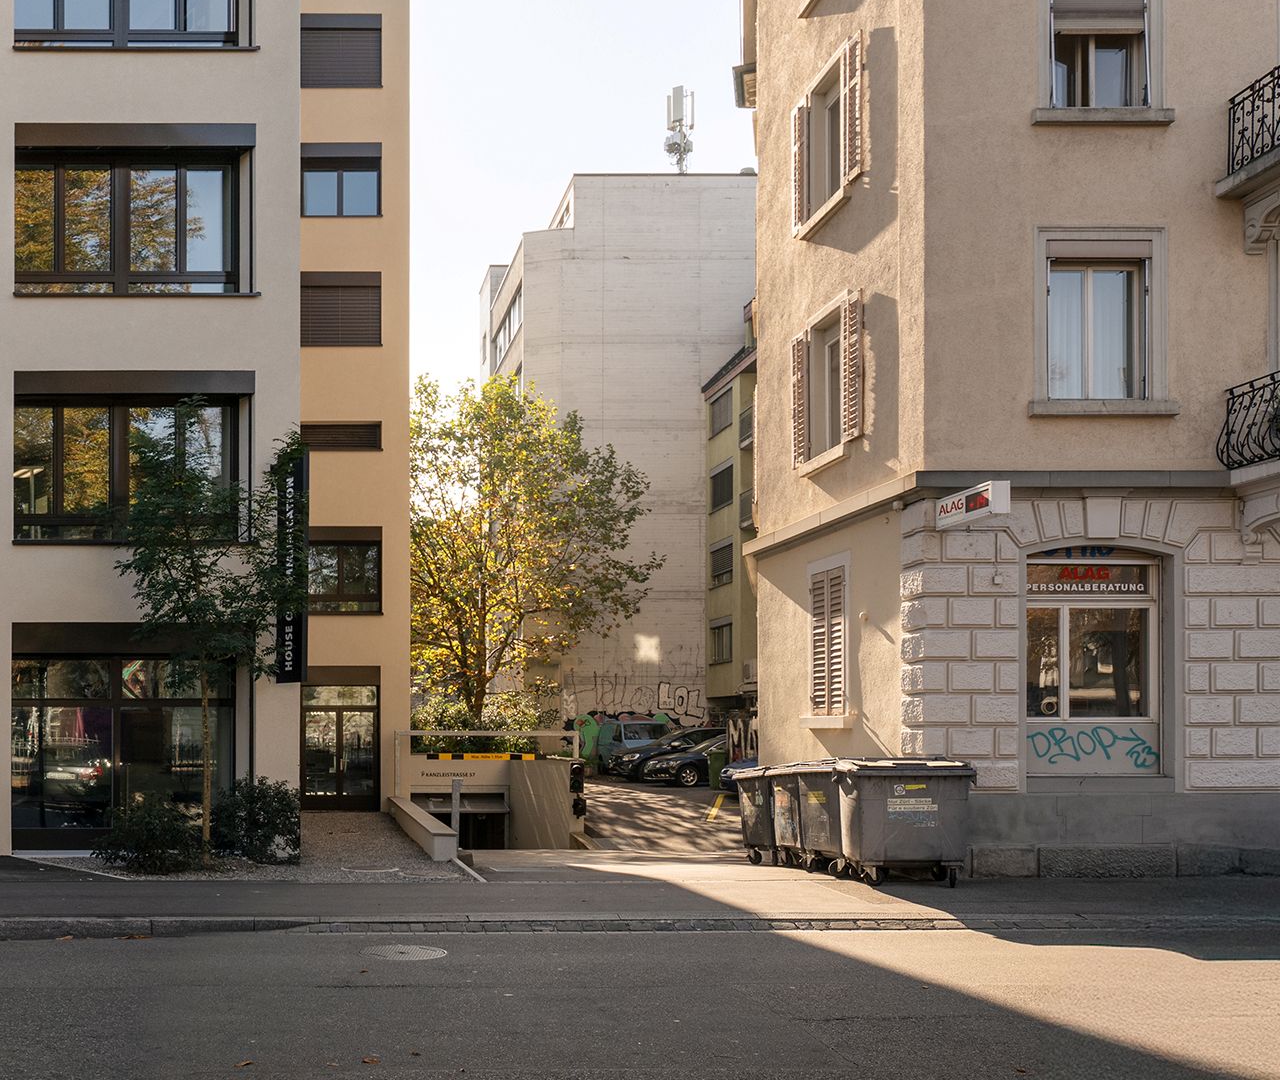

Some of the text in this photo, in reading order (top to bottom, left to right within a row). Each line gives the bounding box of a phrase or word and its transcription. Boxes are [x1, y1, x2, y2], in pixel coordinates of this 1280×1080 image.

[939, 498, 964, 517] ALAG
[1059, 566, 1111, 581] ALAG
[1026, 583, 1145, 592] PERSONALBERATUNG
[285, 625, 293, 671] HOUSE
[658, 681, 705, 719] LOL
